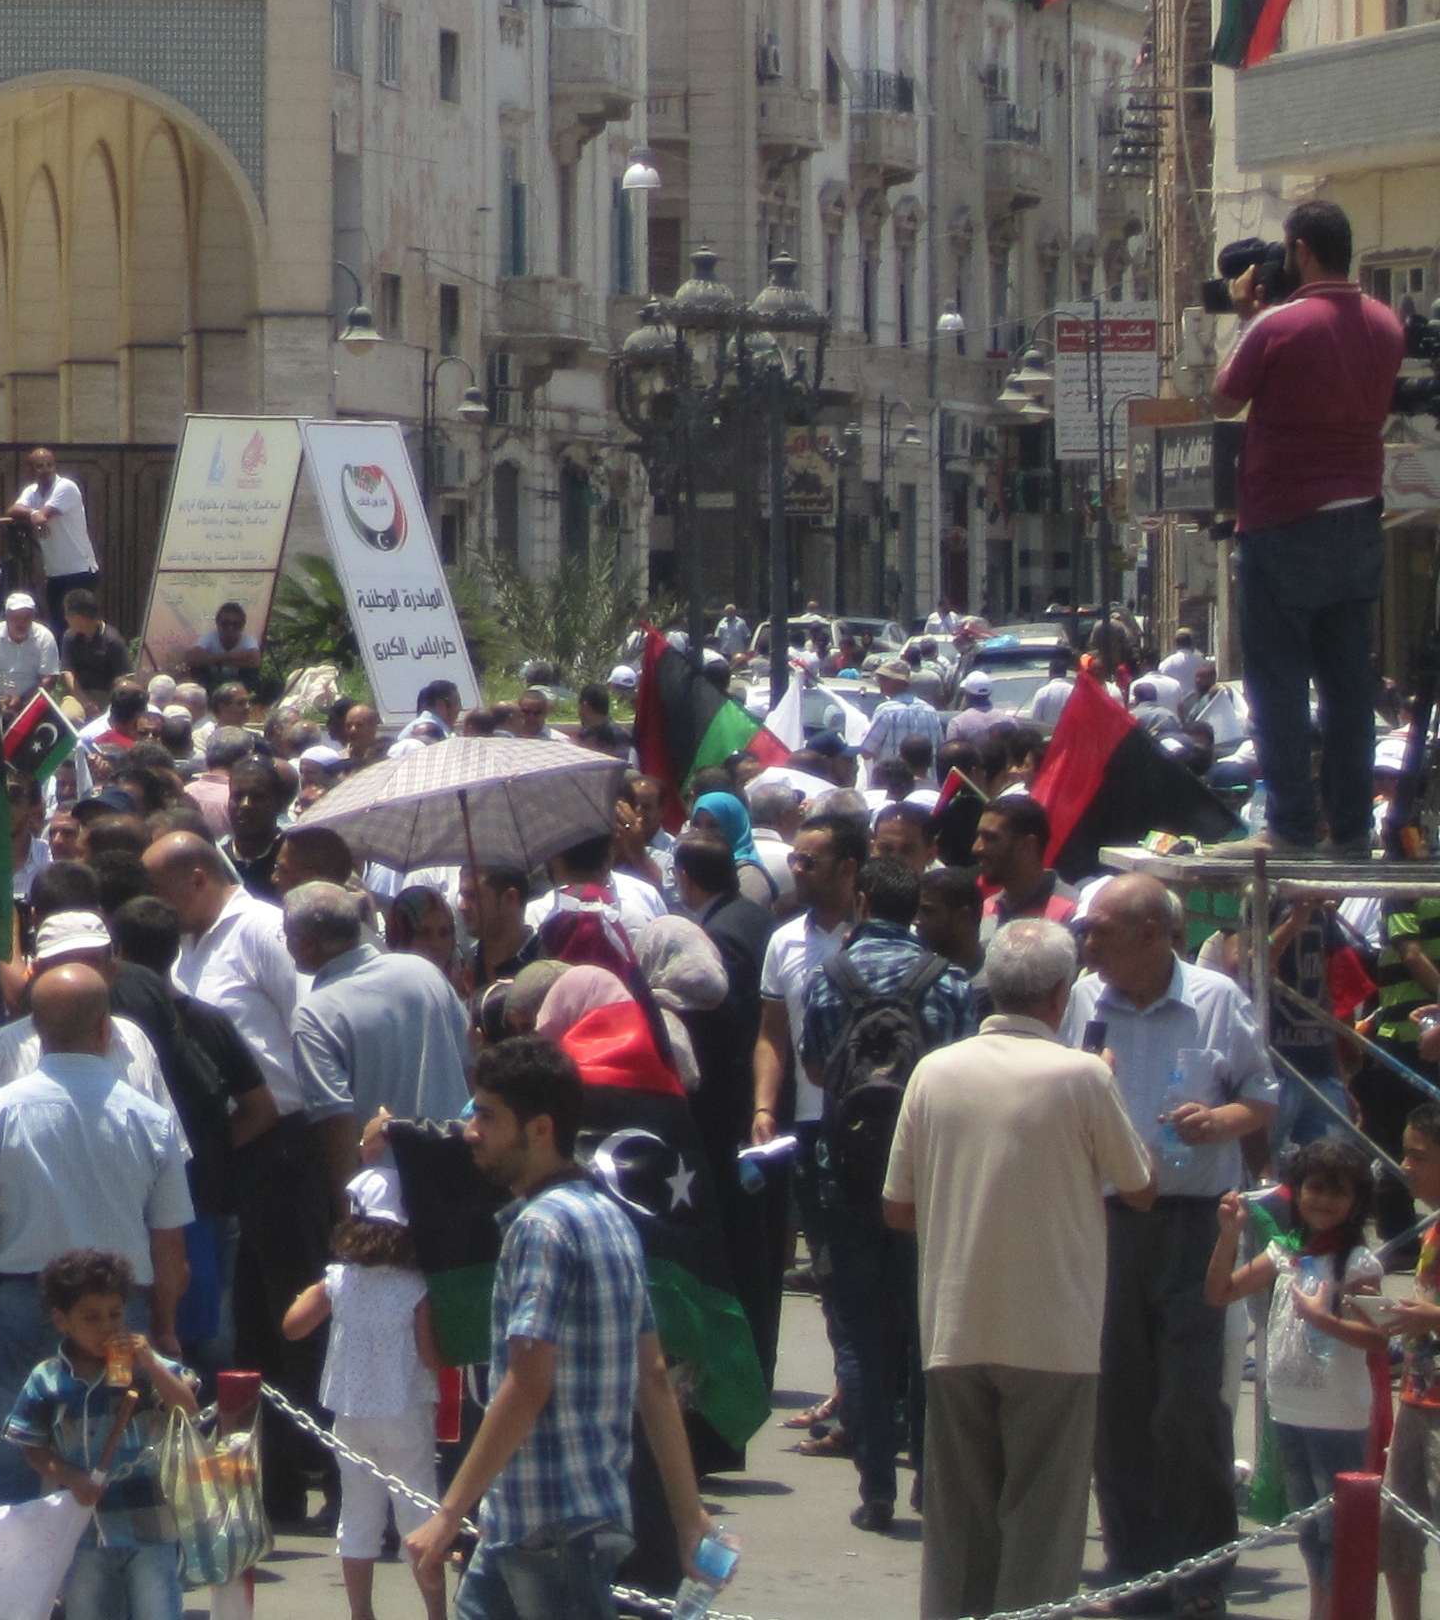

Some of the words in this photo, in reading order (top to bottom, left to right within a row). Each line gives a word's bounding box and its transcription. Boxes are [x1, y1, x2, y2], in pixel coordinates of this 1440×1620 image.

[357, 588, 400, 612] الوطنية
[403, 588, 445, 611] المبادرة
[373, 636, 408, 661] الكبرى
[411, 638, 458, 661] طرابلس
